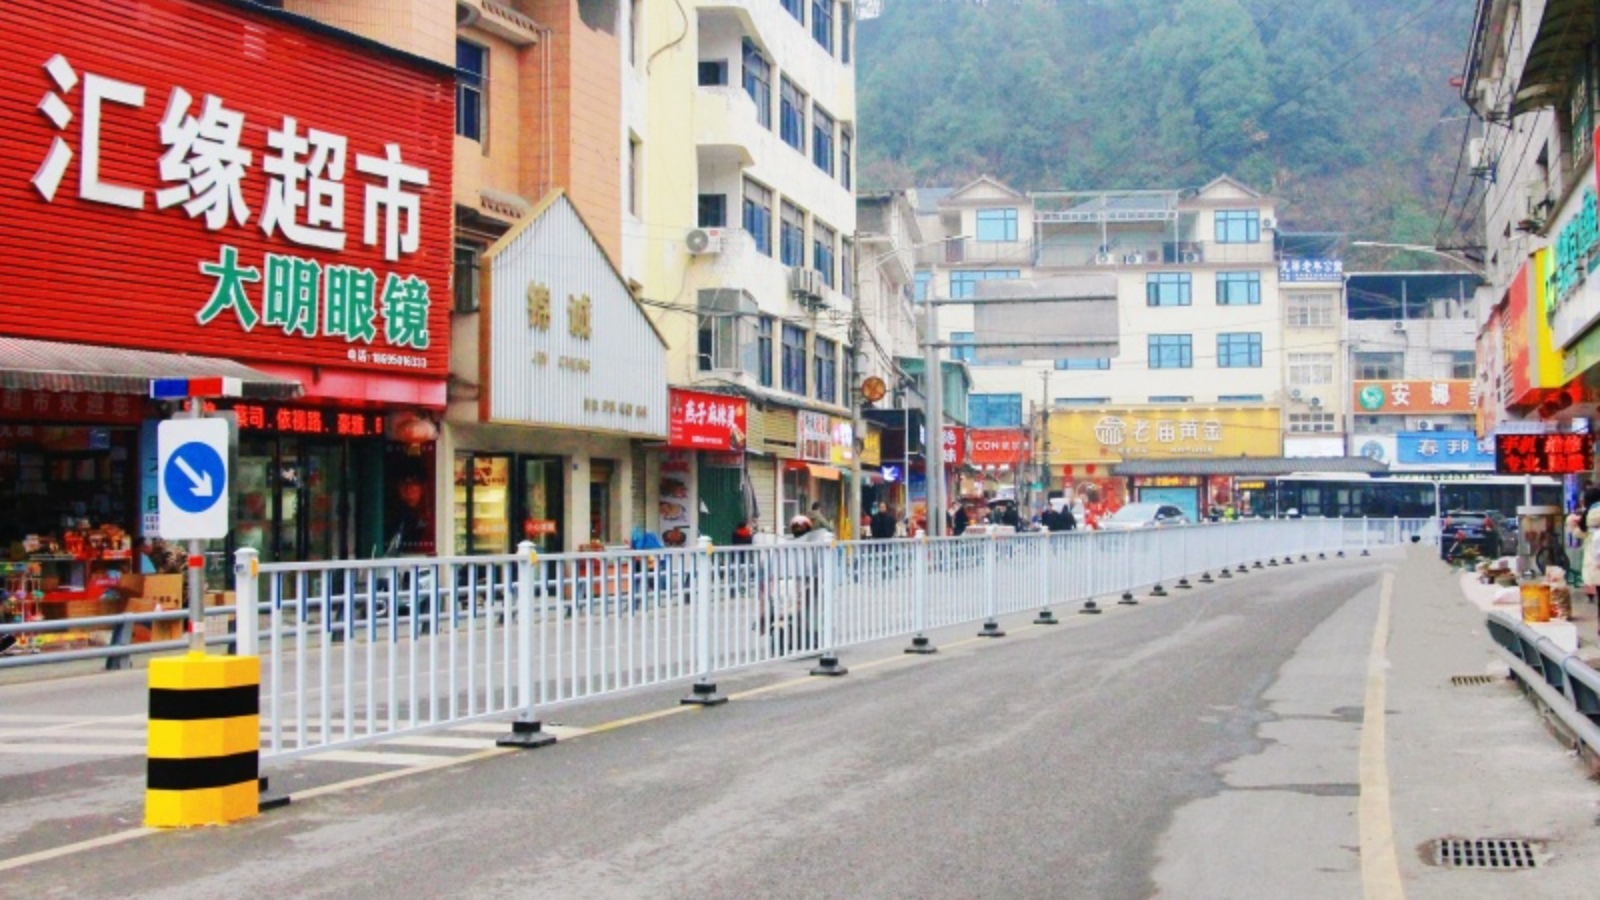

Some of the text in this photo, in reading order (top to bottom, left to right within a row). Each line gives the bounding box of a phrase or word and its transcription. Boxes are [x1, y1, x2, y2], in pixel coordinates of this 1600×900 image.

[31, 54, 429, 261] 汇缘超市
[197, 246, 429, 349] 大明眼镜
[1133, 419, 1222, 442] 老庙黄金
